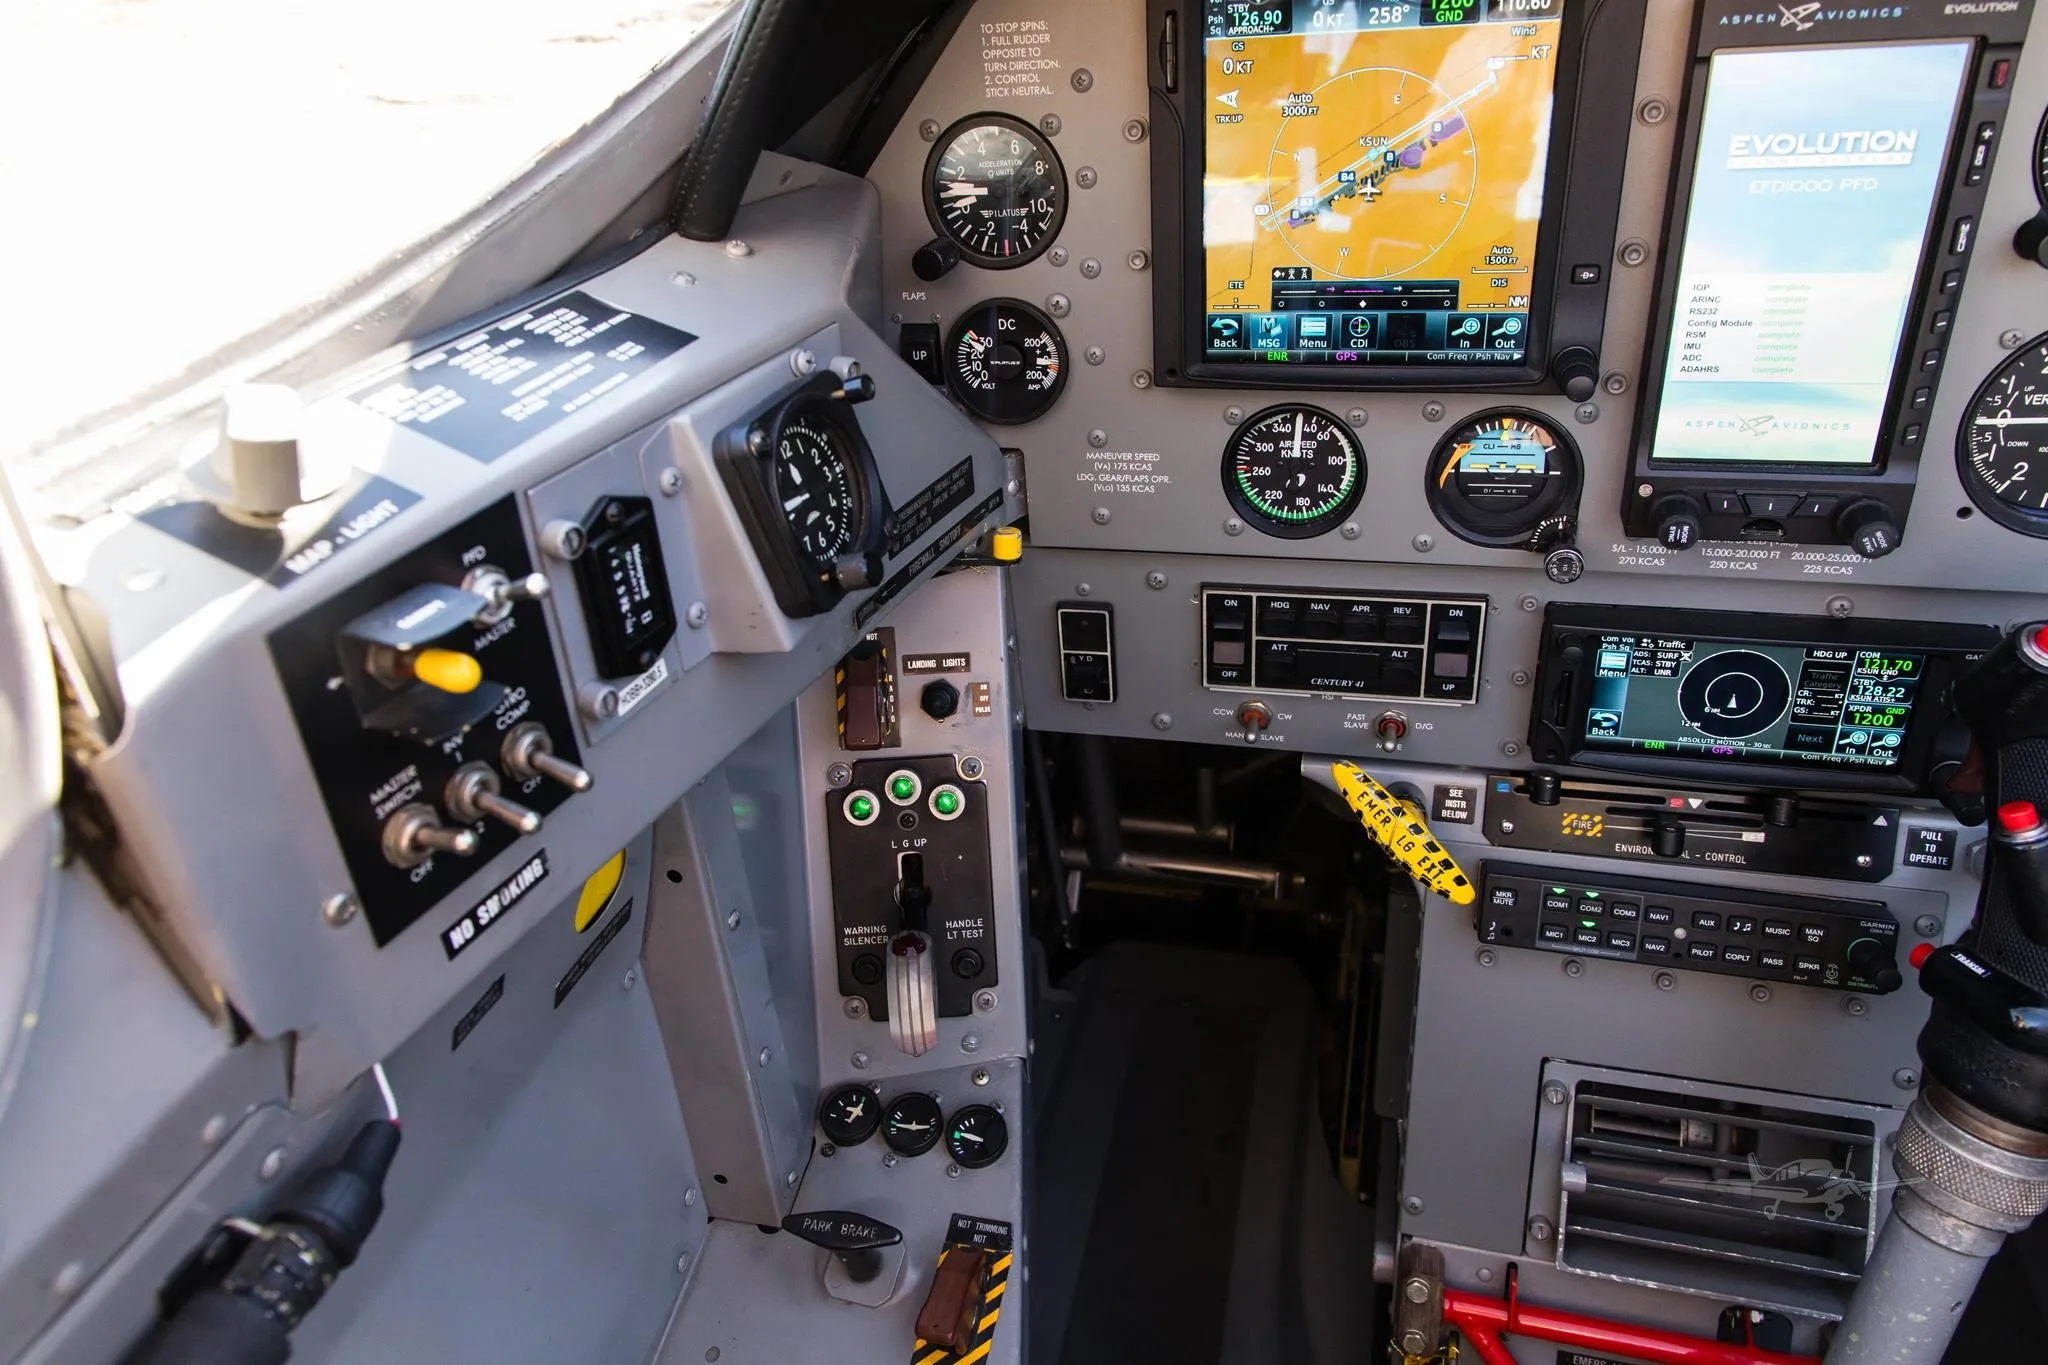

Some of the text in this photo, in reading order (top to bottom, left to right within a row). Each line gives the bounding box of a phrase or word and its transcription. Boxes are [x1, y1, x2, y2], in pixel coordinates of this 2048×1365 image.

[1227, 4, 1250, 13] STBY
[1944, 1, 2018, 15] EVOLUTION
[1233, 11, 1282, 26] 126.90
[1369, 5, 1409, 24] 258°
[1436, 10, 1463, 22] GND
[1719, 7, 1903, 25] ASPEN AVIONICS
[980, 21, 1048, 34] TO STOP SPINS:
[1228, 26, 1275, 35] APPROACH+
[1511, 26, 1537, 36] Wind
[981, 34, 1050, 46] 1. FULL RUDDER
[982, 47, 1041, 59] OPPOSITE TO
[984, 60, 1061, 72] TURN DIRECTION.
[985, 73, 1040, 85] 2. CONTROL
[986, 86, 1053, 97] STICK NEUTRAL.
[1288, 93, 1313, 103] Auto
[1359, 137, 1388, 146] KSUN
[1729, 129, 1919, 156] EVOLUTION
[978, 160, 1022, 168] ACCELERATION
[1840, 177, 1878, 191] PFD
[989, 209, 1020, 218] PILATUS
[1491, 246, 1513, 255] Auto
[902, 292, 926, 301] FLAPS
[1687, 319, 1753, 328] Config Module
[1214, 339, 1238, 348] Back
[1258, 339, 1280, 348] MSG
[1300, 339, 1327, 348] Menu
[1350, 339, 1368, 348] CDI
[1495, 339, 1515, 348] Out
[1267, 352, 1288, 361] ENR
[1335, 352, 1358, 361] GPS
[1272, 424, 1291, 433] 340
[1685, 420, 1850, 431] ASPEN AVIONICS
[1255, 443, 1274, 452] 300
[1086, 452, 1160, 462] MANEUVER SPEED
[1328, 456, 1343, 465] 100
[1253, 467, 1271, 476] 260
[1076, 473, 1172, 484] LDG. GEAR/FLAPS OPR.
[1318, 484, 1334, 493] 140
[1265, 491, 1282, 500] 220
[1296, 498, 1310, 506] 180
[462, 546, 488, 567] PFD
[1702, 548, 1780, 560] 15,000-20,000 FT
[1791, 552, 1860, 563] 20,000-25,000
[1619, 556, 1665, 567] 270 KCAS
[1709, 560, 1757, 571] 250 KCAS
[1803, 565, 1853, 576] 225 KCAS
[1270, 601, 1290, 609] HDG
[1310, 603, 1331, 611] NAV
[1351, 605, 1371, 613] APR
[473, 617, 517, 652] MASTER
[866, 633, 878, 641] NOT
[1657, 640, 1686, 649] Traffic
[1391, 651, 1409, 659] ALT
[1860, 651, 1880, 659] COM
[908, 658, 966, 669] LANDING LIGHTS
[1864, 658, 1912, 671] 121.70
[1599, 669, 1626, 678] Menu
[1310, 677, 1366, 689] CENTURY 41
[1857, 686, 1905, 698] 128.22
[1213, 708, 1234, 716] CCW
[1848, 705, 1873, 713] XPDR
[496, 701, 530, 731] COMP
[1347, 713, 1366, 721] FAST
[1854, 713, 1893, 726] 1200
[1344, 721, 1369, 730] SLAVE
[1592, 728, 1616, 736] Back
[1260, 734, 1285, 742] SLAVE
[1798, 734, 1823, 743] Next
[443, 735, 466, 755] INV
[1645, 741, 1665, 749] ENR
[1712, 746, 1734, 755] GPS
[1873, 748, 1893, 757] Out
[1822, 755, 1841, 763] Freq
[1866, 757, 1883, 765] Nav
[368, 764, 419, 805] MASTER
[1449, 789, 1463, 798] SEE
[375, 780, 422, 819] SWITCH
[1445, 799, 1466, 809] INSTR
[1441, 809, 1467, 819] BELOW
[1573, 820, 1593, 830] FIRE
[1356, 791, 1445, 884] EMER. LG EXT.
[1920, 831, 1943, 842] PULL
[1925, 843, 1936, 853] TO
[1909, 853, 1948, 867] OPERATE
[410, 858, 435, 883] OFF
[449, 858, 544, 949] NO SMOKING
[1547, 901, 1568, 909] COM1
[1580, 905, 1602, 913] COM2
[1613, 908, 1636, 917] COM3
[1650, 913, 1669, 921] NAV1
[946, 919, 983, 929] HANDLE
[1699, 919, 1715, 927] AUX
[1860, 921, 1895, 930] GARMIN
[844, 925, 887, 936] WARNING
[947, 930, 983, 940] LT TEST
[1765, 927, 1791, 936] MUSIC
[1805, 928, 1823, 936] MAN
[844, 935, 889, 946] SILENCER
[1578, 934, 1597, 943] MIC2
[1612, 938, 1630, 947] MIC3
[1645, 943, 1665, 951] NAV2
[1692, 948, 1713, 957] PILOT
[1725, 953, 1750, 962] COPLT
[1763, 958, 1783, 966] PASS
[1799, 962, 1819, 971] SPKR
[1955, 953, 1986, 975] TRANSM
[803, 1218, 877, 1239] PARK BRAKE
[958, 1219, 971, 1229] NOT
